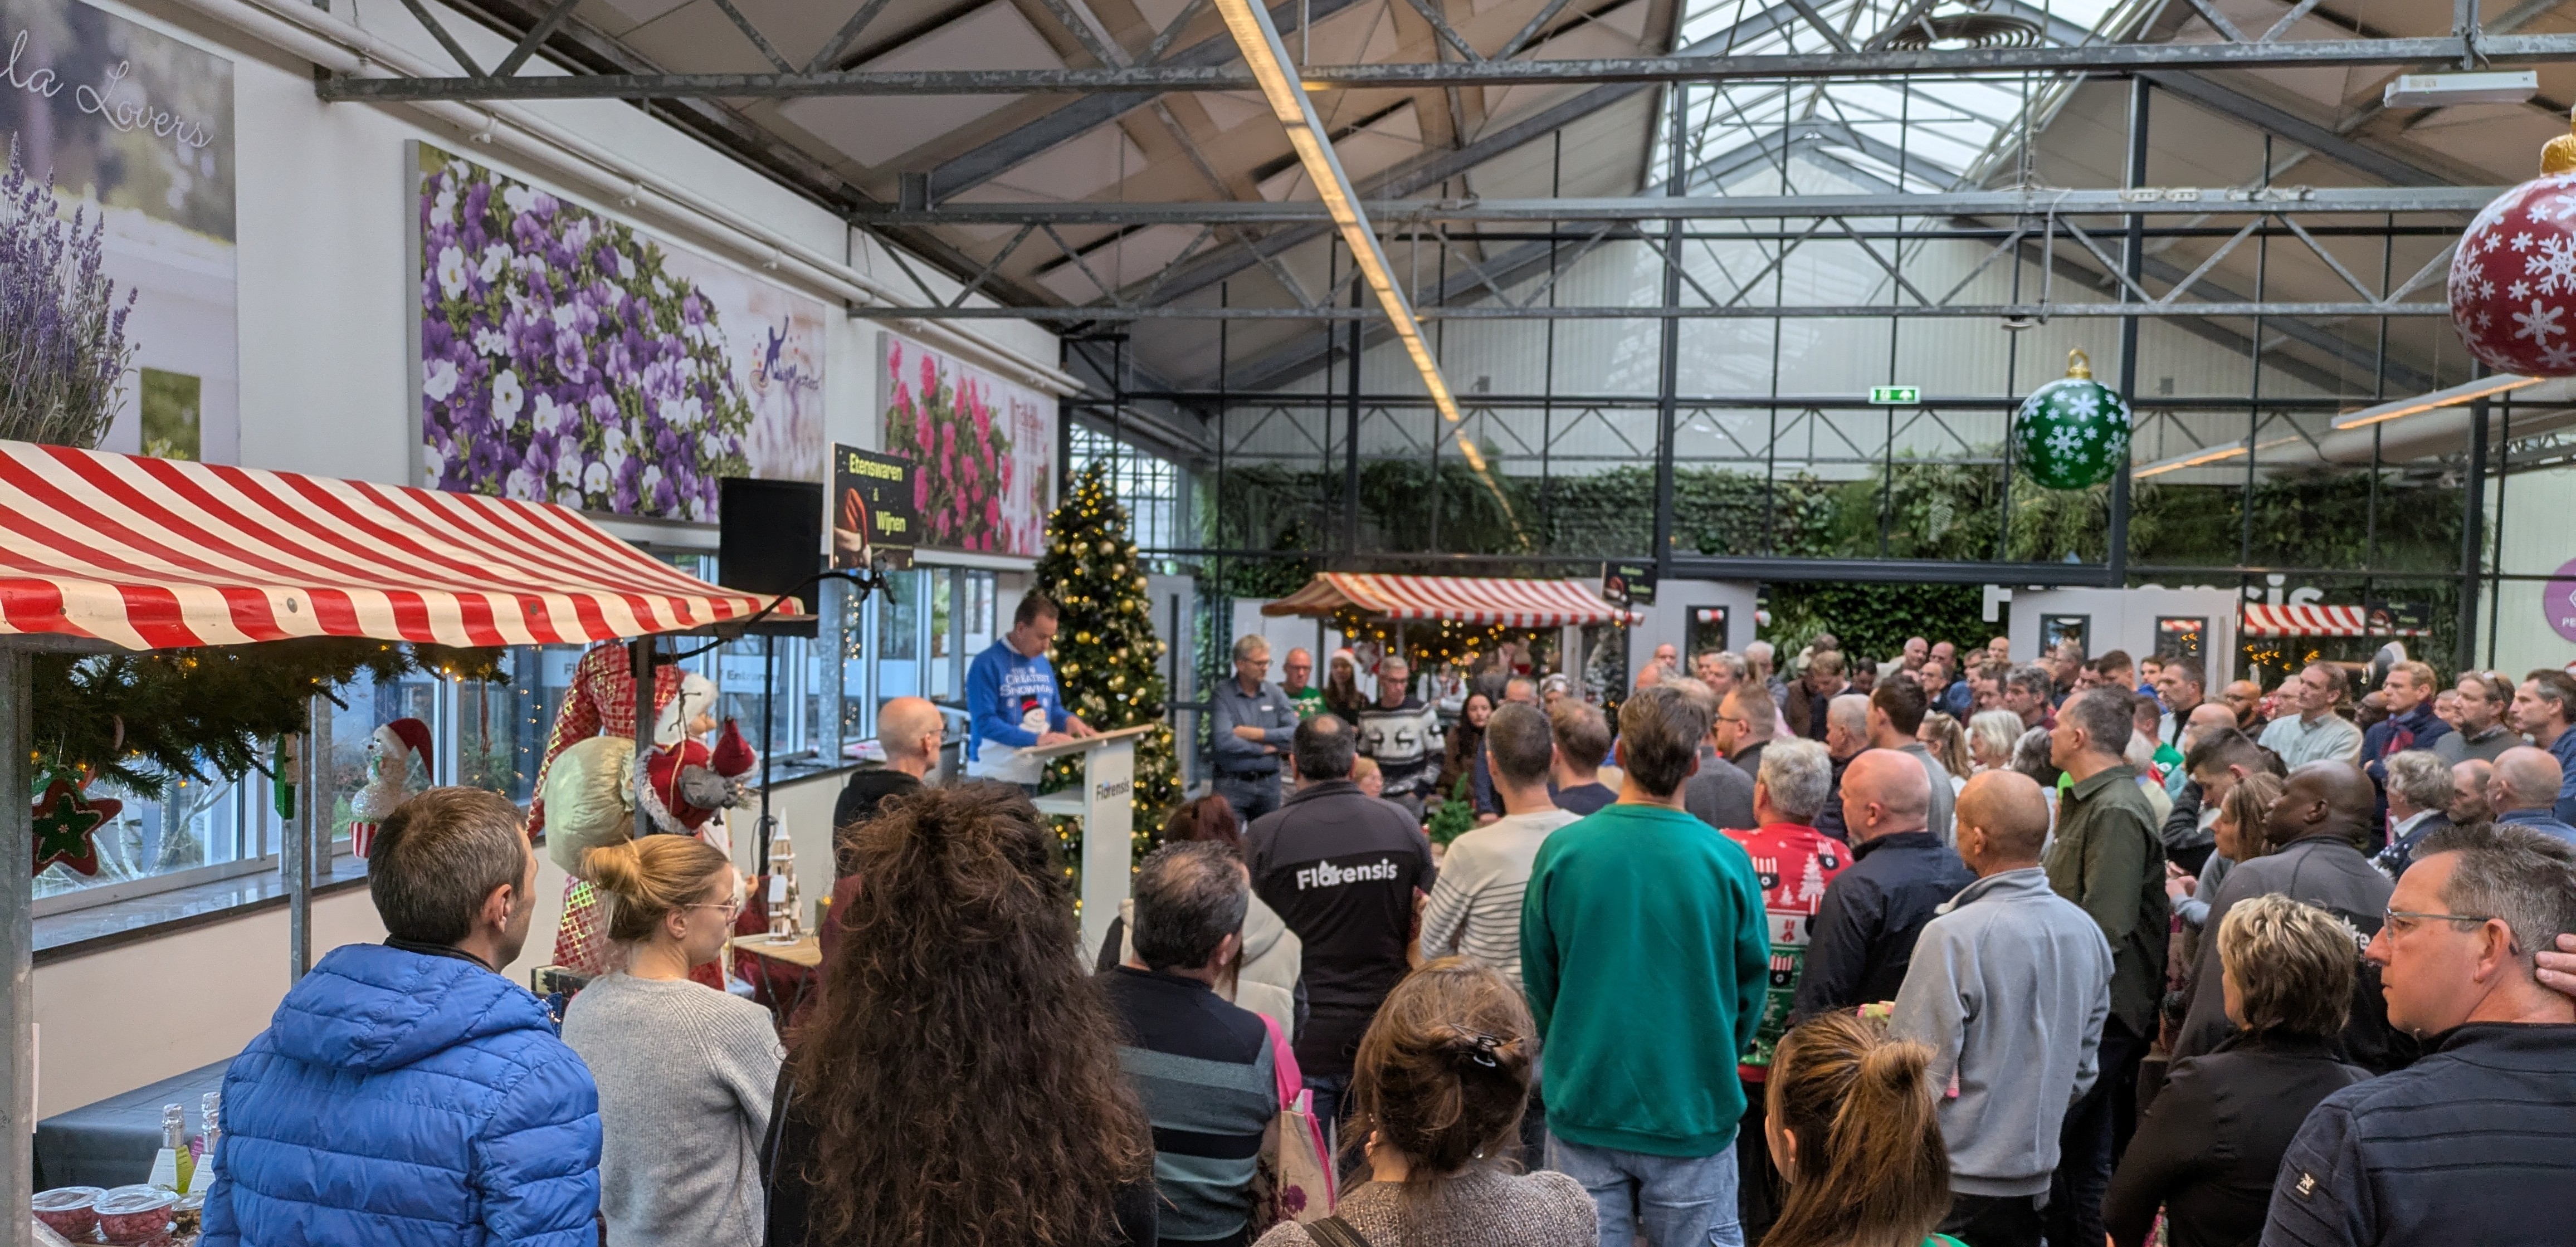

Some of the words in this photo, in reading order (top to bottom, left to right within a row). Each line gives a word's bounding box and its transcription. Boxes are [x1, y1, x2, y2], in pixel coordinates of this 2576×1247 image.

[76, 60, 213, 149] Lovers
[848, 452, 904, 482] Etenswaren
[876, 510, 906, 536] Wijnen
[1096, 777, 1130, 802] Florensis
[1296, 858, 1398, 890] Florensis
